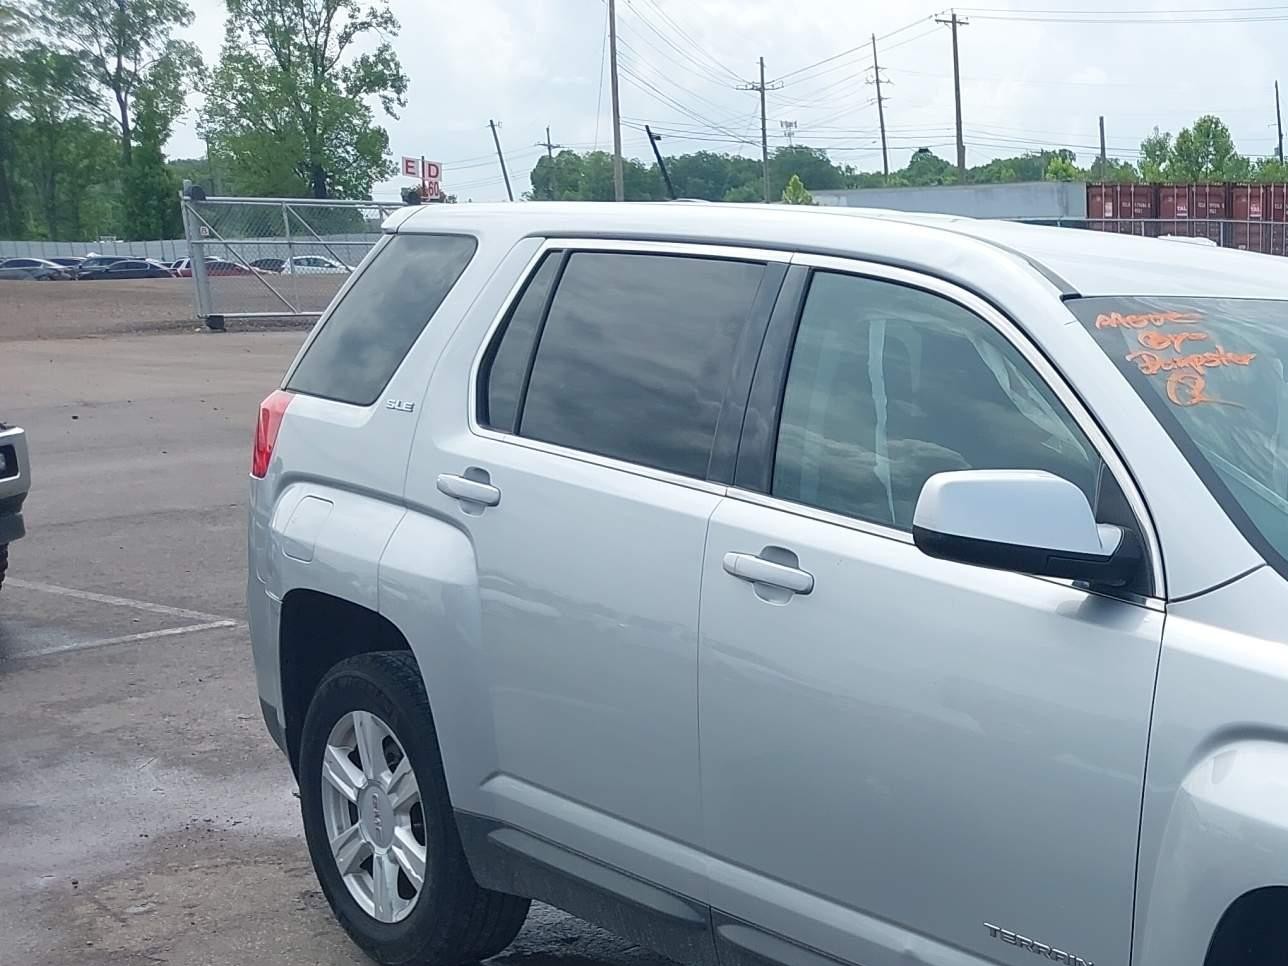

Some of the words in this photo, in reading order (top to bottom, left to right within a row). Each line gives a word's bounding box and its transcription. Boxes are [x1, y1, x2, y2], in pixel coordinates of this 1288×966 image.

[405, 159, 416, 175] E
[428, 163, 440, 178] D
[386, 399, 415, 413] SLE
